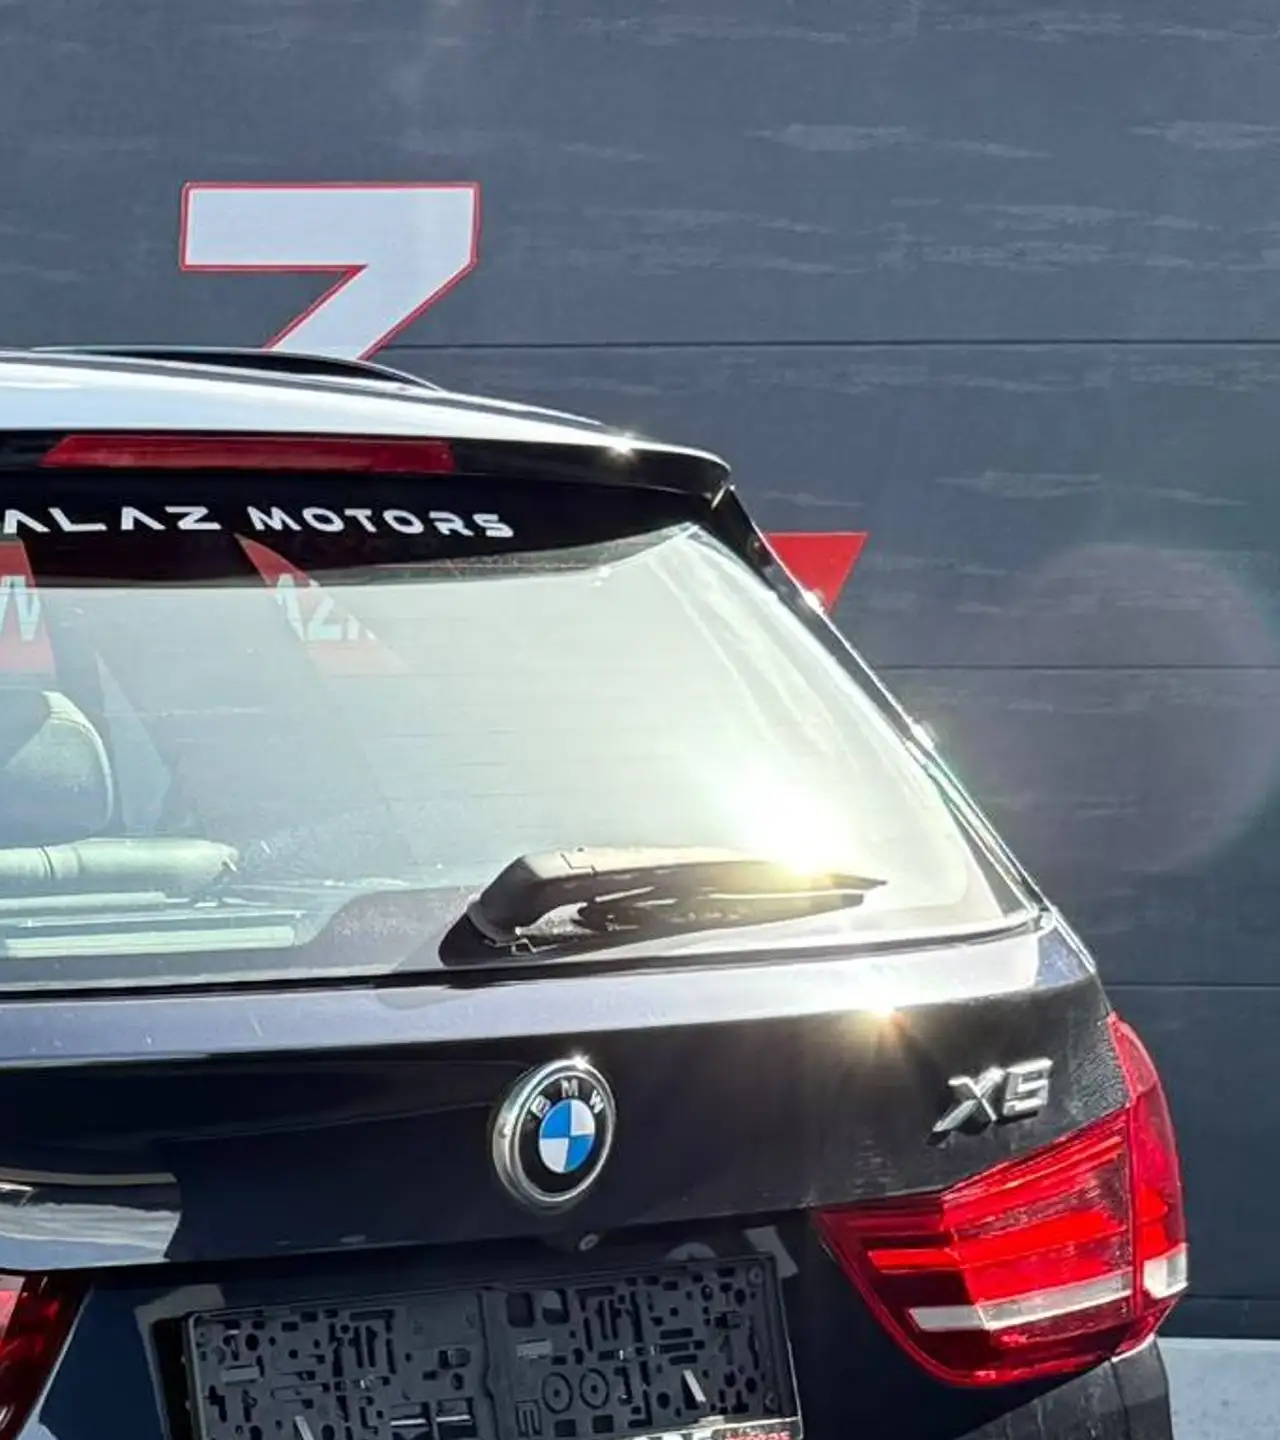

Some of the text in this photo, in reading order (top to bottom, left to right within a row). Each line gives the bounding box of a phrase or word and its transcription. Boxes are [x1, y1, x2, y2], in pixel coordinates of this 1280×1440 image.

[246, 505, 515, 539] MOTORS
[529, 1077, 606, 1120] BMW
[932, 1057, 1054, 1133] X5
